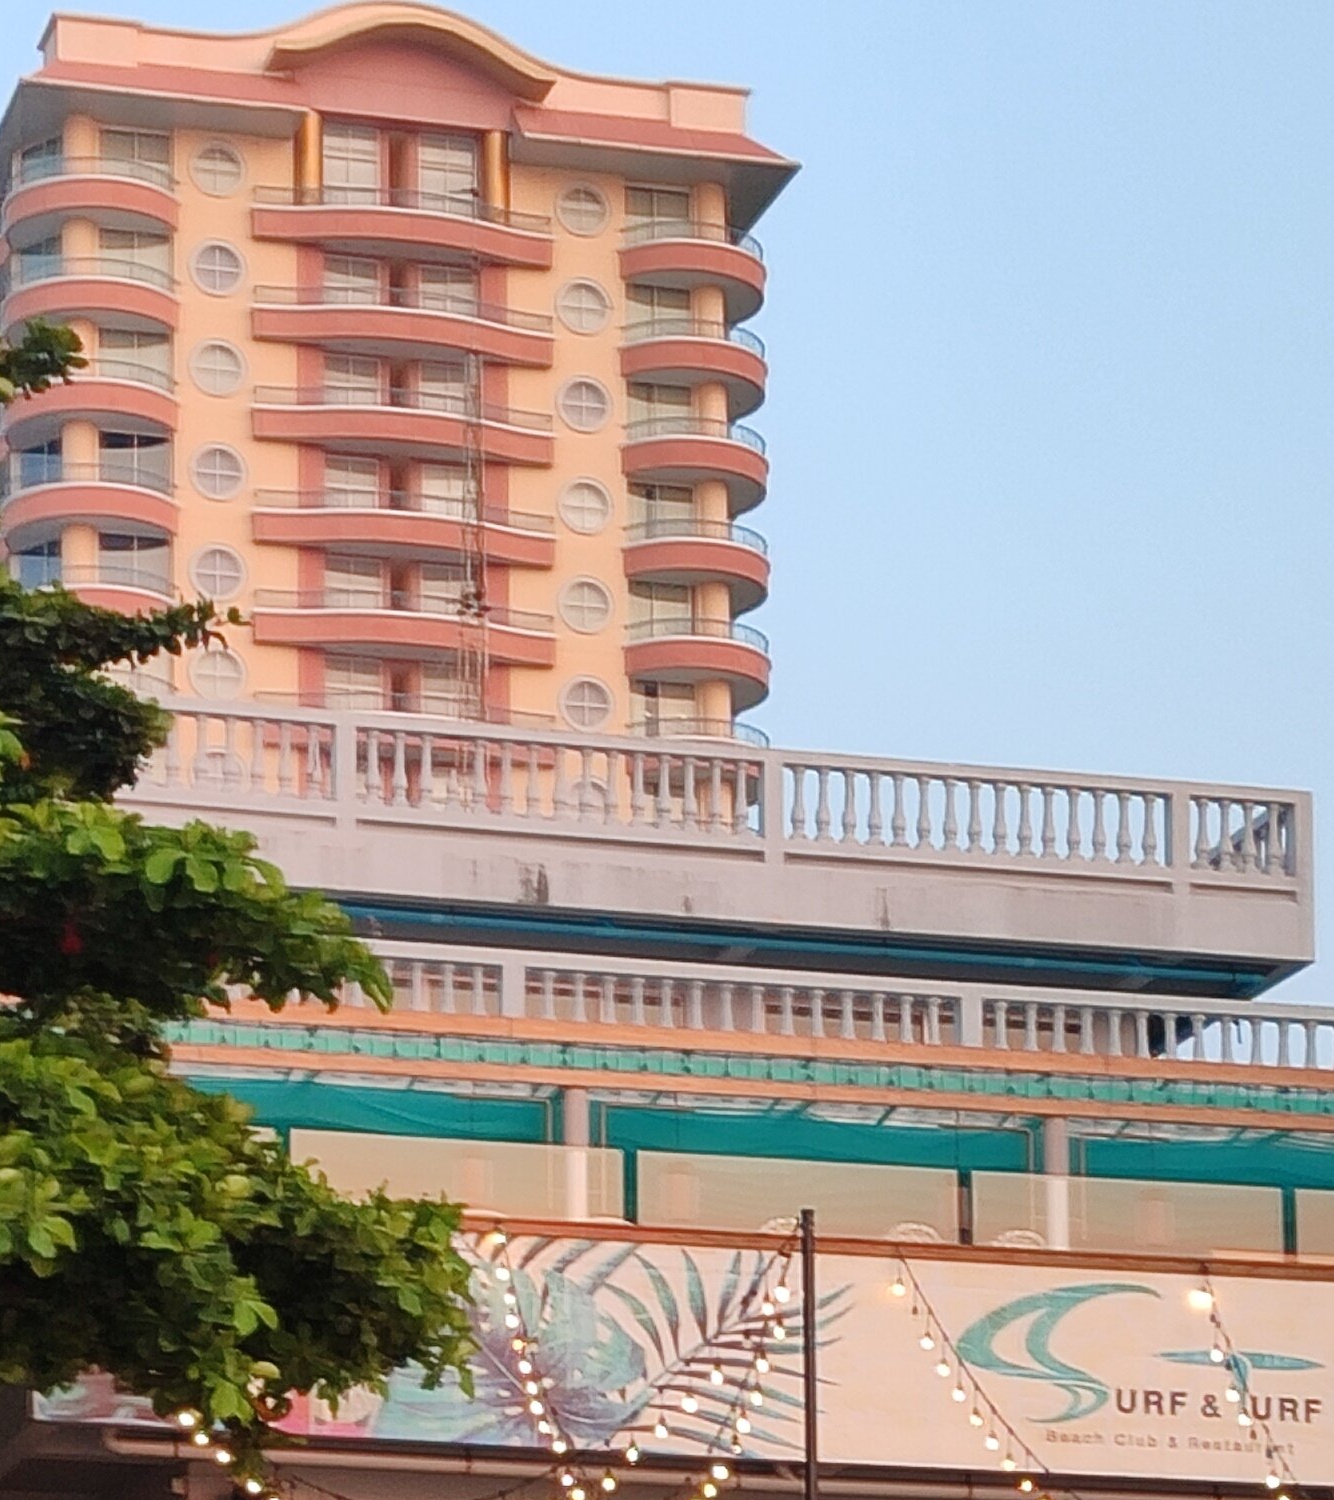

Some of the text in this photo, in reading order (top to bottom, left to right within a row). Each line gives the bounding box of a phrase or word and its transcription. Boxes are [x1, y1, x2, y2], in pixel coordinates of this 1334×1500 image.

[957, 1282, 1189, 1423] SURF
[1200, 1394, 1221, 1418] &
[1045, 1429, 1295, 1457] Beach Club & Restaurnt
